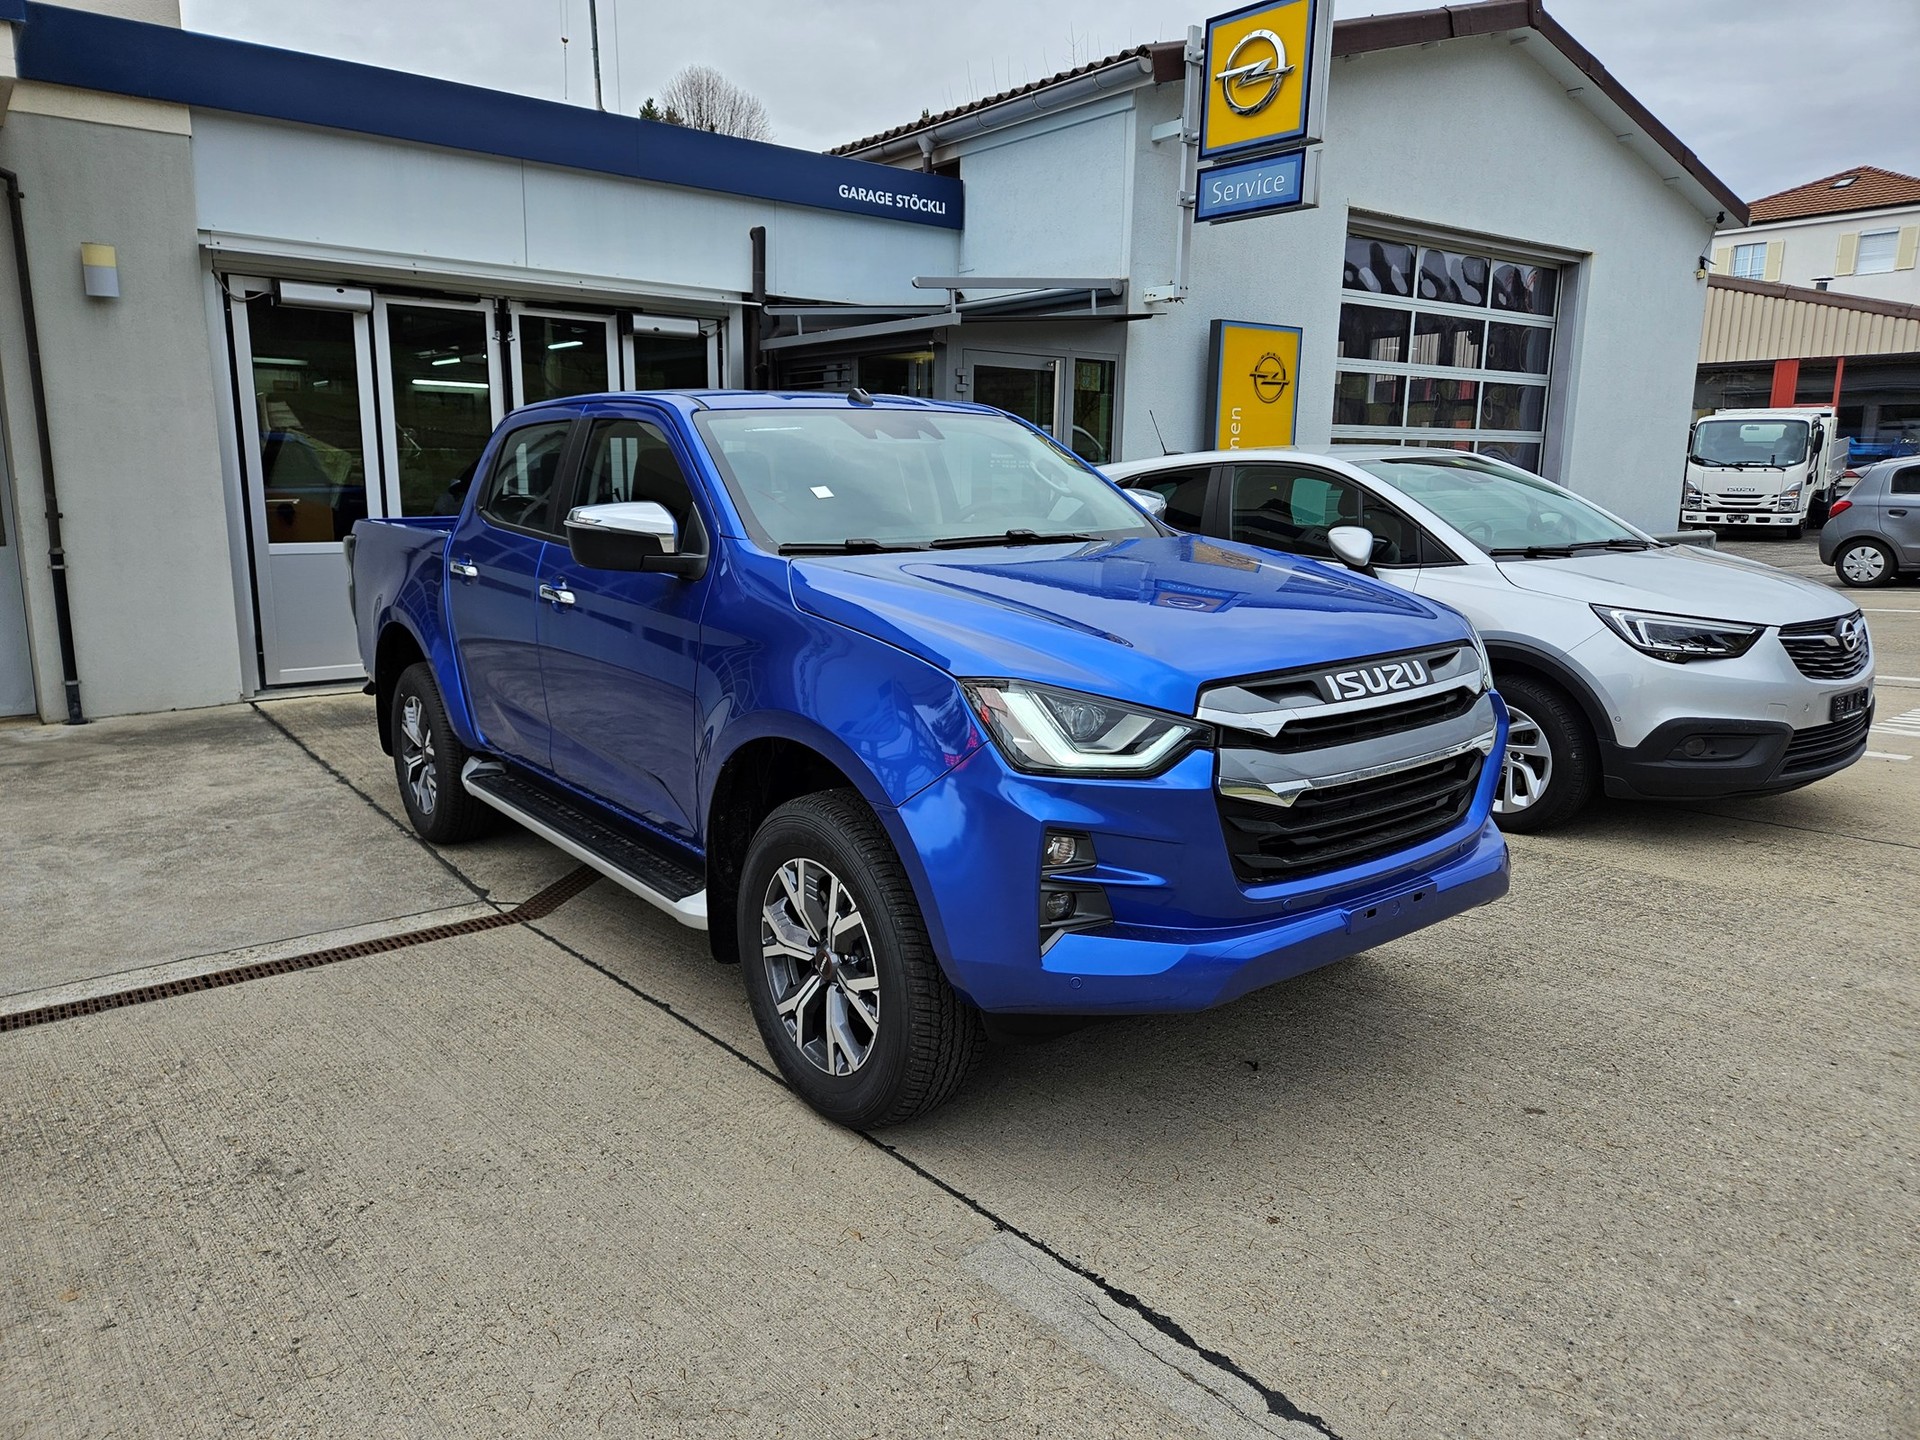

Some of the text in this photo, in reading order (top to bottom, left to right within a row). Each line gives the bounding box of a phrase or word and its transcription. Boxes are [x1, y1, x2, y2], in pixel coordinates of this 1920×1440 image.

[838, 184, 946, 215] GARAGE STÖCKLI
[1212, 172, 1285, 204] Service
[1325, 660, 1428, 700] ISUZU
